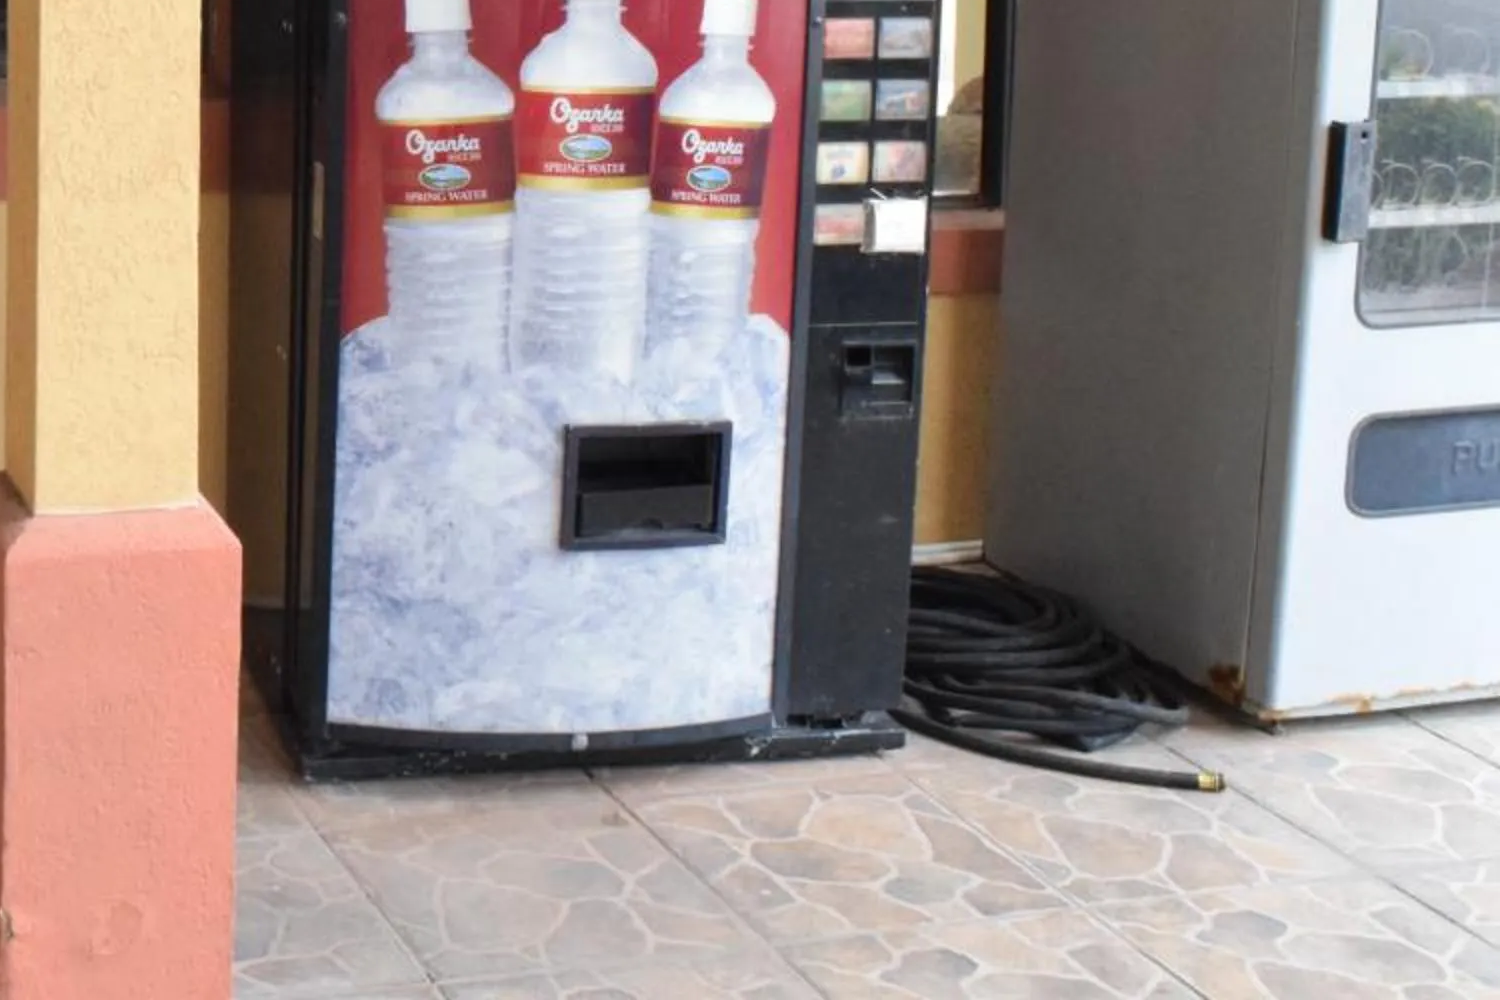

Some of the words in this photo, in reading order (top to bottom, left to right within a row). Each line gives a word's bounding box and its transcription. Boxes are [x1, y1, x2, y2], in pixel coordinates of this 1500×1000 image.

[550, 97, 624, 133] Ozarka
[405, 128, 480, 164] Ozarka
[681, 128, 744, 164] Ozarka
[587, 163, 626, 174] WATER
[448, 189, 488, 201] WATER
